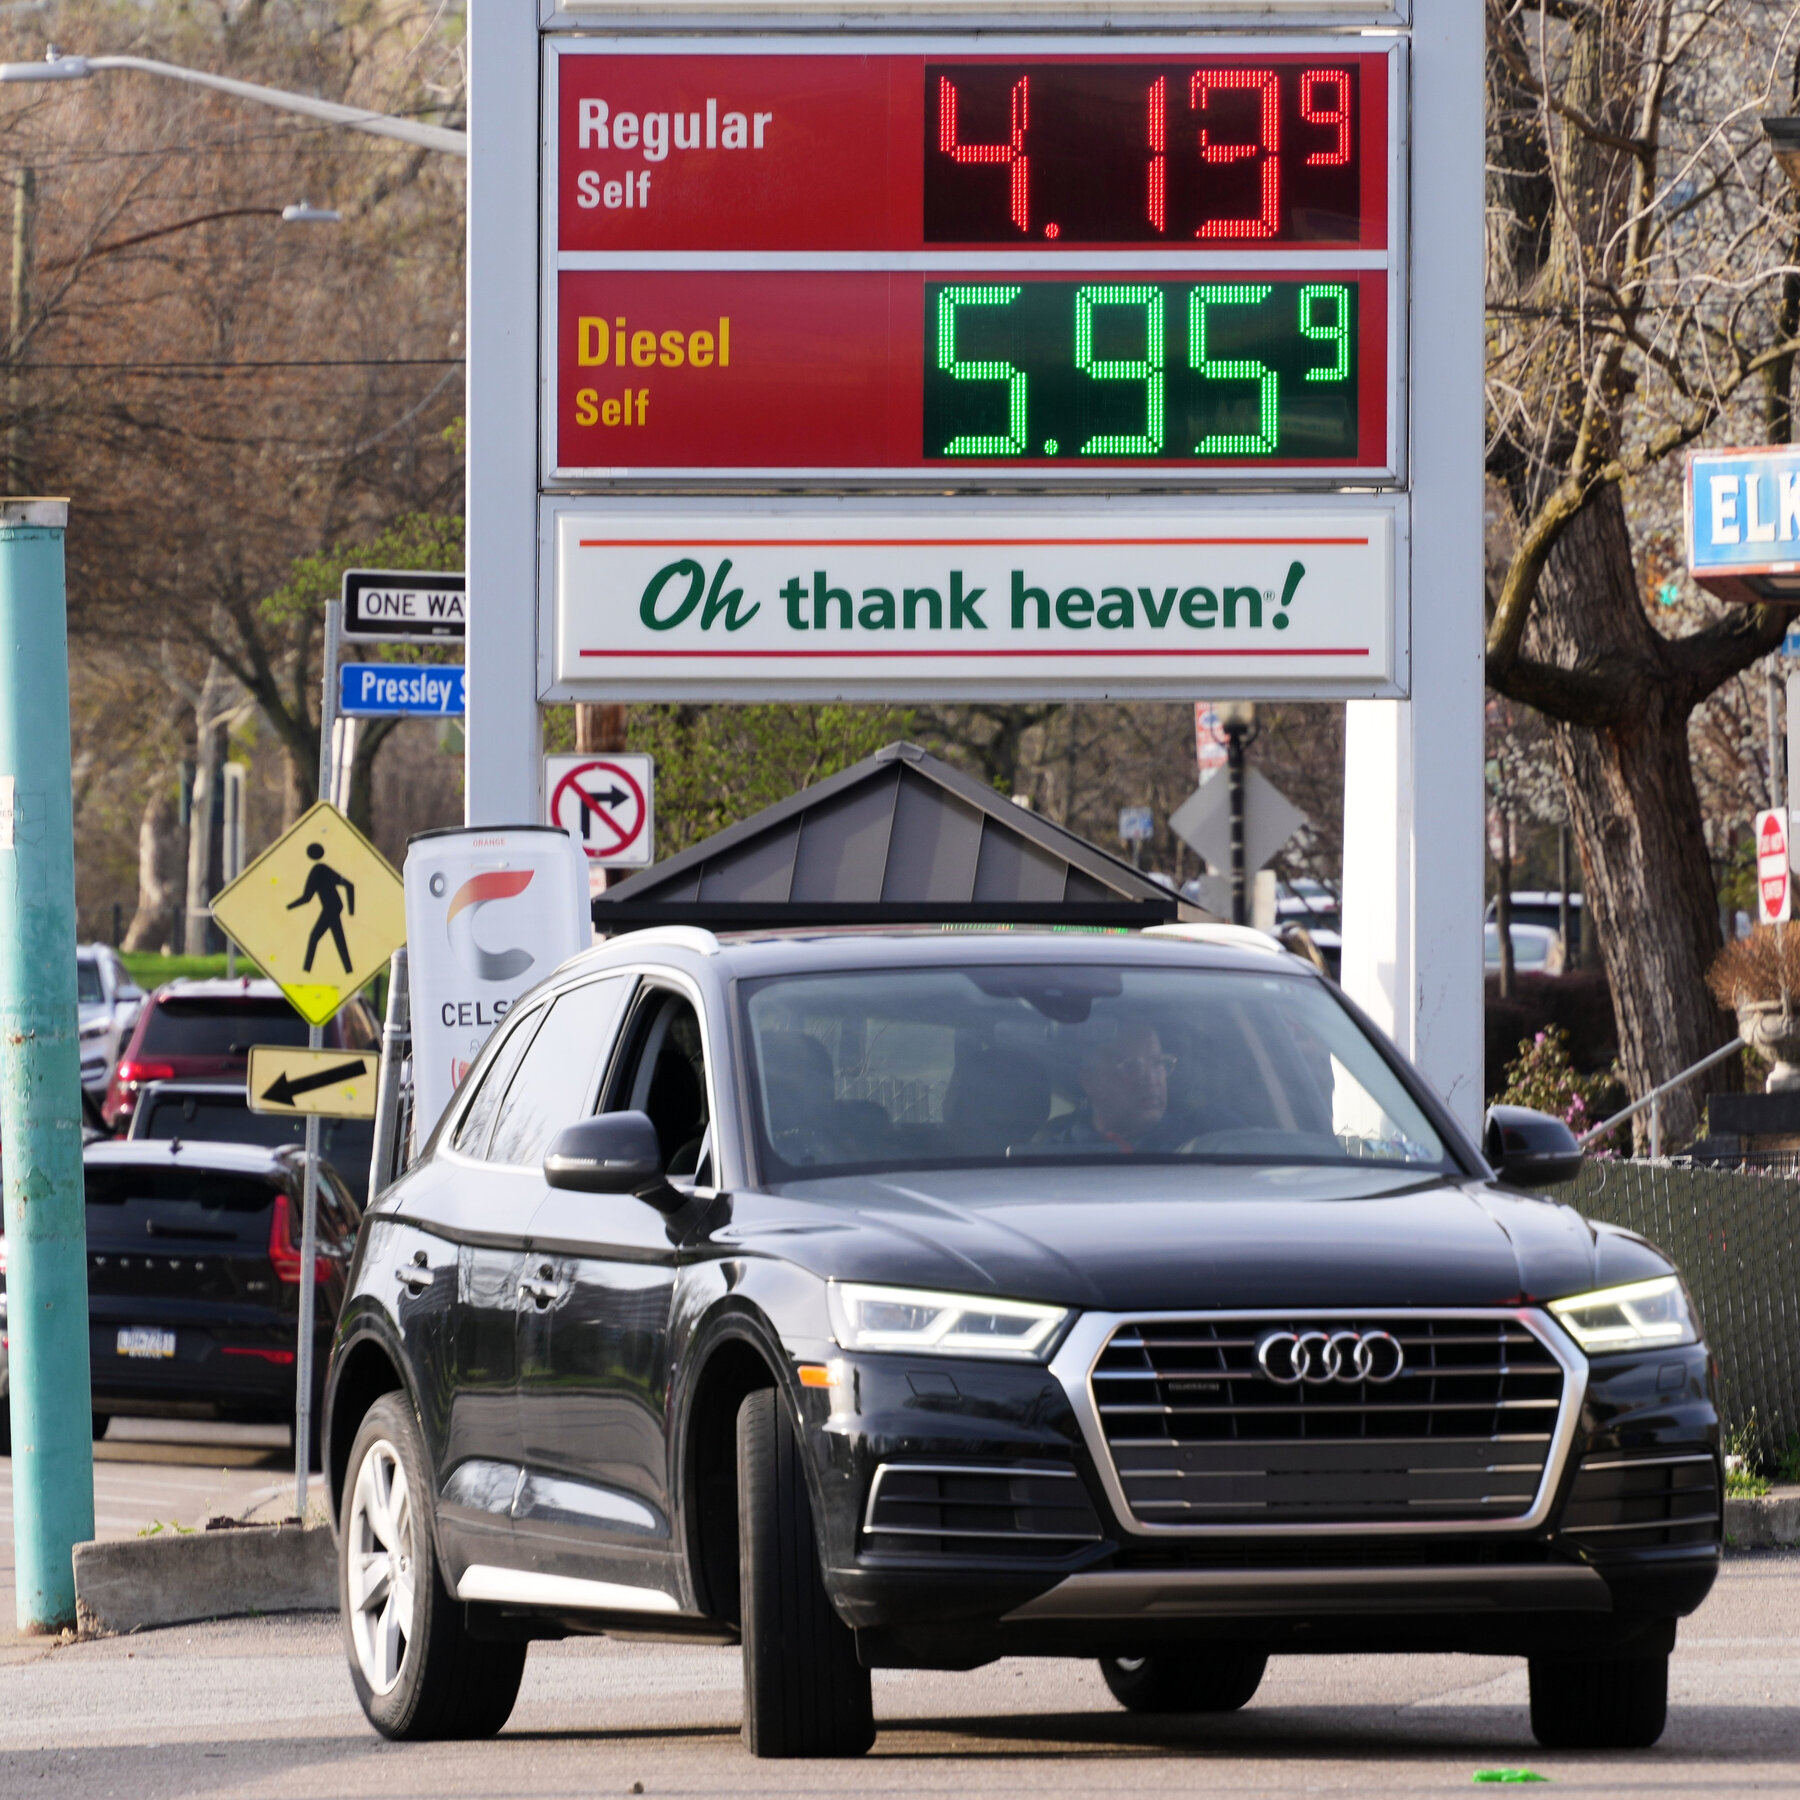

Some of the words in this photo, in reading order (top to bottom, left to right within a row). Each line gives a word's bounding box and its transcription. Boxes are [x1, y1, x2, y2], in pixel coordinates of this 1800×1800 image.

[579, 98, 772, 162] Regular
[577, 170, 651, 208] Self
[578, 316, 730, 368] Diesel
[576, 388, 650, 426] Self
[366, 592, 416, 616] ONE
[428, 594, 465, 618] WA
[639, 558, 761, 631] Oh
[779, 570, 988, 630] thank
[361, 671, 452, 712] Pressley
[441, 1000, 516, 1028] CELS
[95, 1256, 204, 1272] VOLVO
